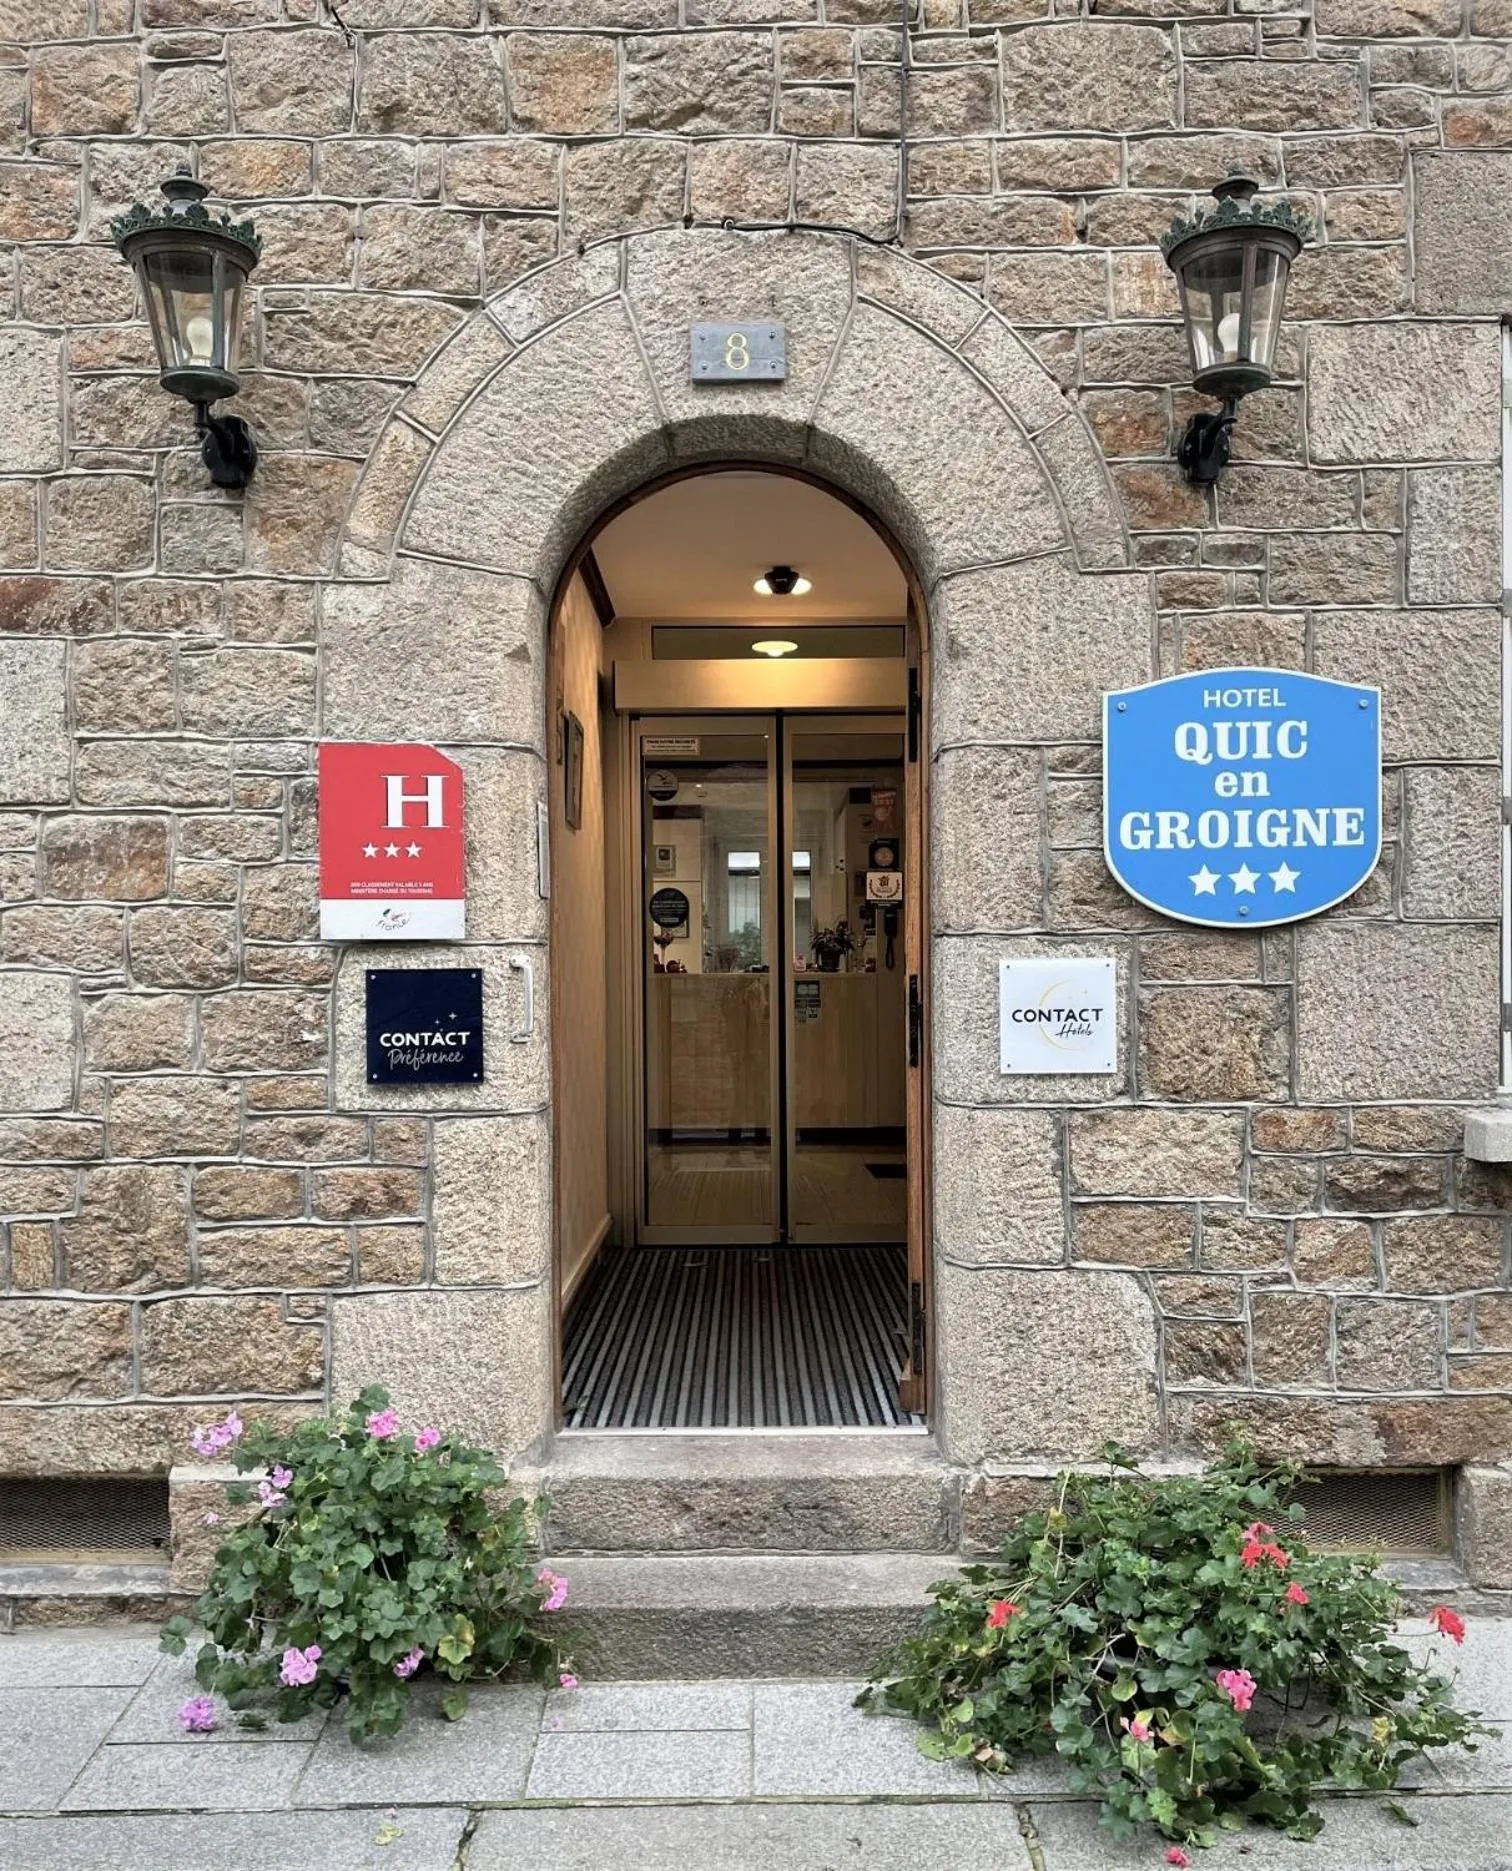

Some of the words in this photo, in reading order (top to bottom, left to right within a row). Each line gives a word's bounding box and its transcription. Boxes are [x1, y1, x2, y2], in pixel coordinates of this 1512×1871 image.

[726, 332, 749, 370] 8
[1203, 688, 1286, 708] HOTEL
[1174, 720, 1307, 765] QUIC
[1214, 771, 1270, 797] en
[381, 775, 449, 828] H
[1119, 807, 1364, 850] GROIGNE
[1011, 1008, 1104, 1023] CONTACT
[379, 1031, 471, 1047] CONTACT
[1055, 1023, 1094, 1040] Hotels
[388, 1047, 464, 1072] Préférence
